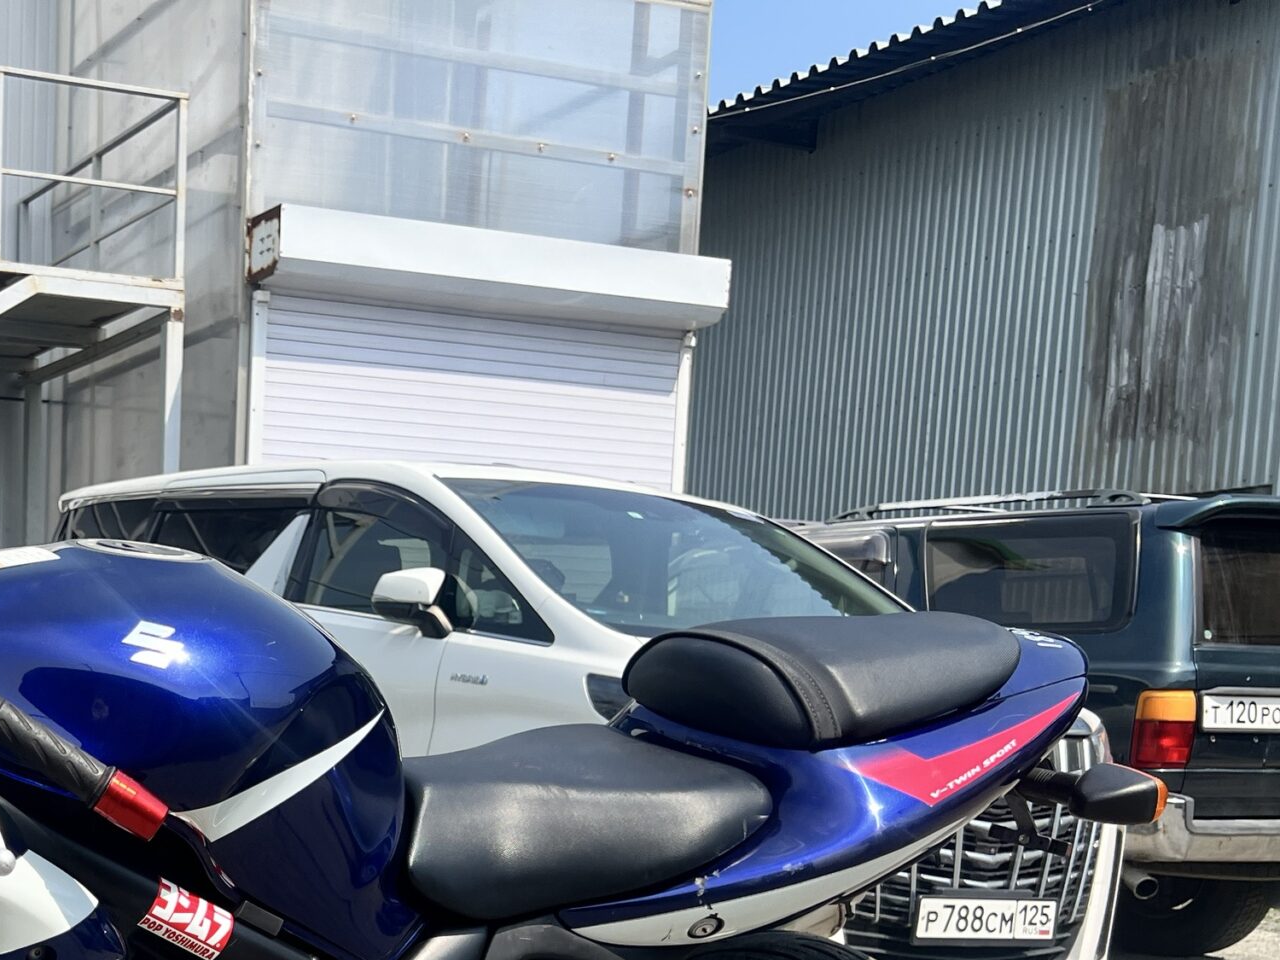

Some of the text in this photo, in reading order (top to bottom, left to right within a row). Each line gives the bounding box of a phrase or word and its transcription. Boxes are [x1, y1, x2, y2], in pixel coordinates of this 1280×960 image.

[930, 739, 1017, 798] V-TWIN SPORT
[140, 917, 216, 960] POP YOSHIMURA
